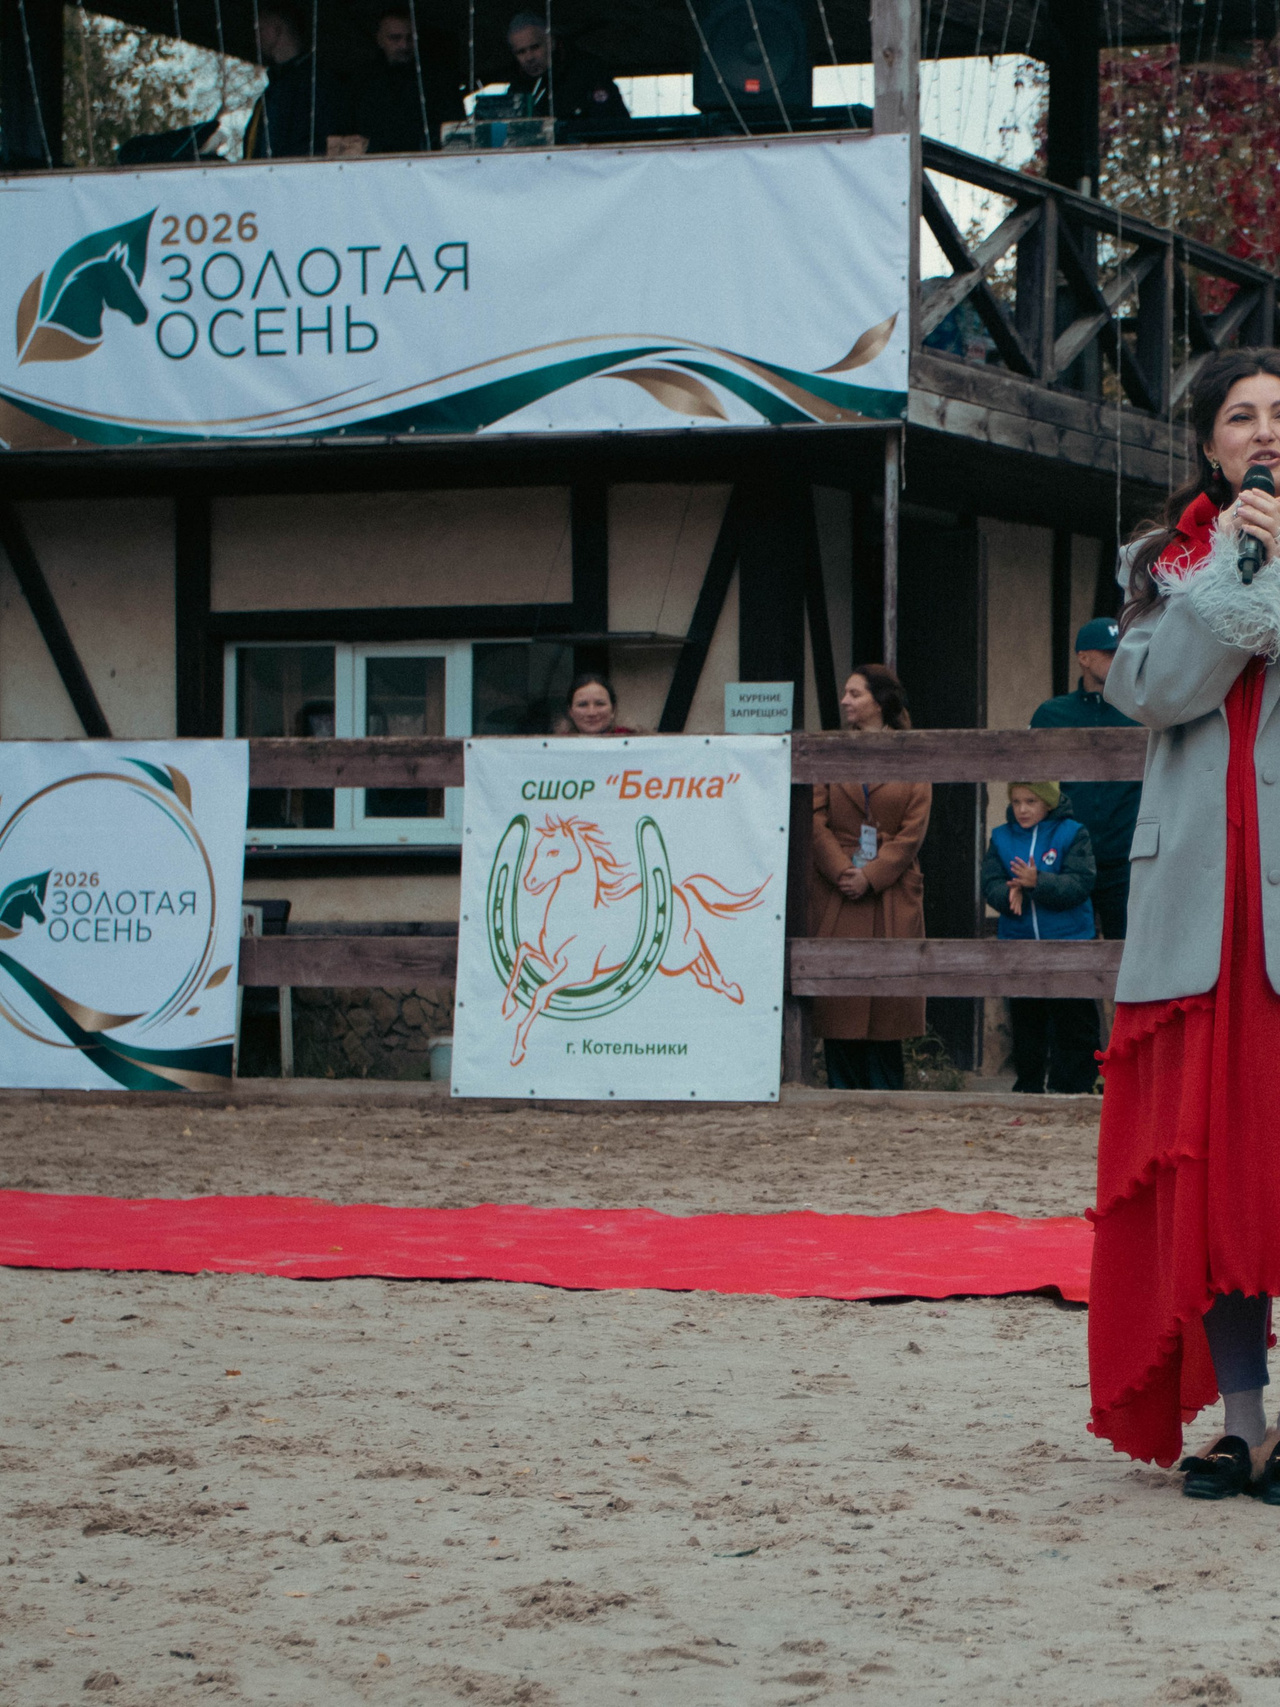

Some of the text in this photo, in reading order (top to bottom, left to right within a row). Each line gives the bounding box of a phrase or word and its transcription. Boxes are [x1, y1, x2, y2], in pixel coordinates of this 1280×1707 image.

[160, 211, 260, 246] 2026
[160, 241, 469, 303] ЗОЛОТАЯ
[155, 304, 379, 361] ОСЕНЬ
[738, 693, 781, 703] КУРЕНИЕ
[730, 707, 789, 719] ЗАПРЕЩЕНО
[520, 779, 596, 801] СШОР
[53, 871, 100, 888] 2026
[51, 890, 197, 916] ЗОЛОТАЯ
[48, 917, 152, 943] ОСЕНЬ
[566, 1039, 688, 1055] г. Котельники
